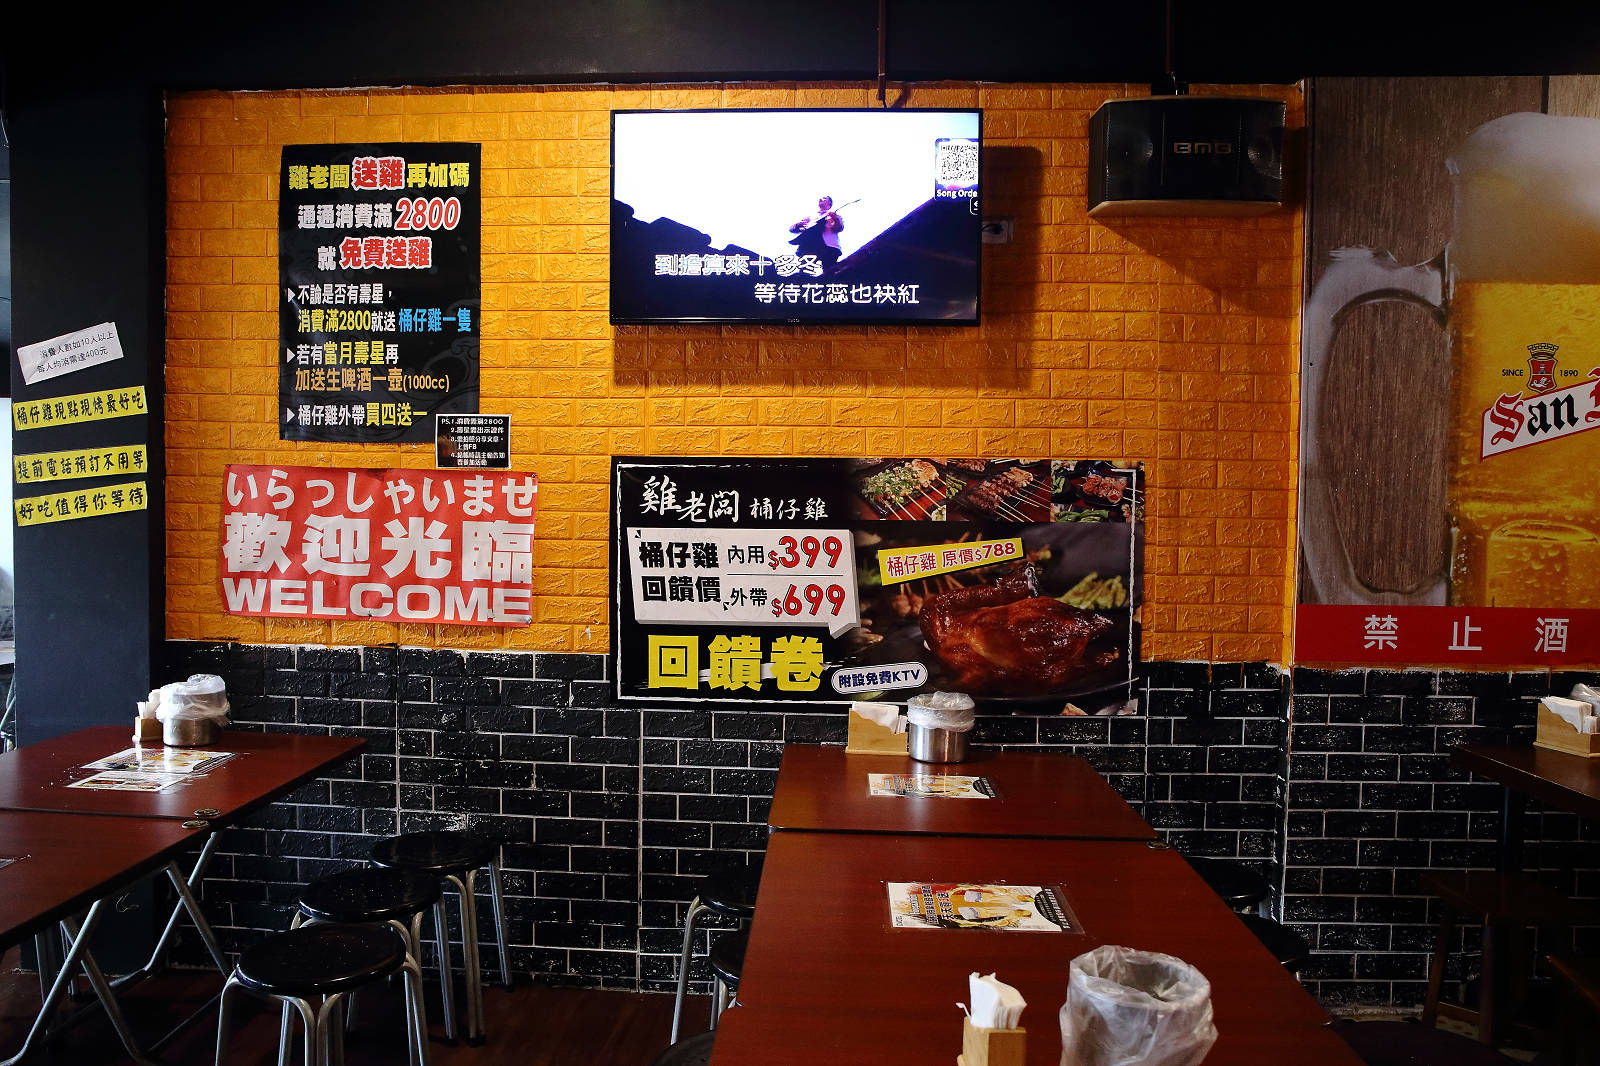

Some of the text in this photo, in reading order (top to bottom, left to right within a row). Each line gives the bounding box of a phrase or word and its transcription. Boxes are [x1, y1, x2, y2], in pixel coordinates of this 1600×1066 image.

[288, 156, 470, 191] 雞老闆送雞再加碼
[936, 189, 957, 199] Song
[297, 197, 461, 231] 通通消費滿2800
[317, 236, 433, 271] 就免費送雞
[753, 282, 920, 305] 等待花蕊也袂紅
[297, 307, 472, 333] 消費滿2800就送桶仔雞一隻
[296, 341, 399, 365] 若有當月壽星再
[295, 367, 450, 393] 加送生啤酒一壺(1000cc)
[1501, 368, 1579, 377] SINCE 1890
[16, 391, 145, 426] 桶仔雞現點現烤最好吃
[297, 403, 428, 427] 桶仔雞外帶買四送一
[1489, 391, 1580, 445] San
[17, 450, 144, 479] 提前電話預訂不用等
[18, 487, 144, 520] 好吃值得你等待
[226, 468, 538, 517] いらっしゃいませ
[639, 475, 829, 523] 雞老闆 桶仔雞
[222, 511, 535, 584] 歡迎光臨
[638, 541, 720, 569] 桶仔雞
[886, 552, 938, 577] 桶仔雞
[222, 577, 532, 623] WELCOME
[641, 575, 722, 603] 回饋價
[647, 634, 825, 692] 回饋卷
[838, 669, 921, 688] 附設免費KTV
